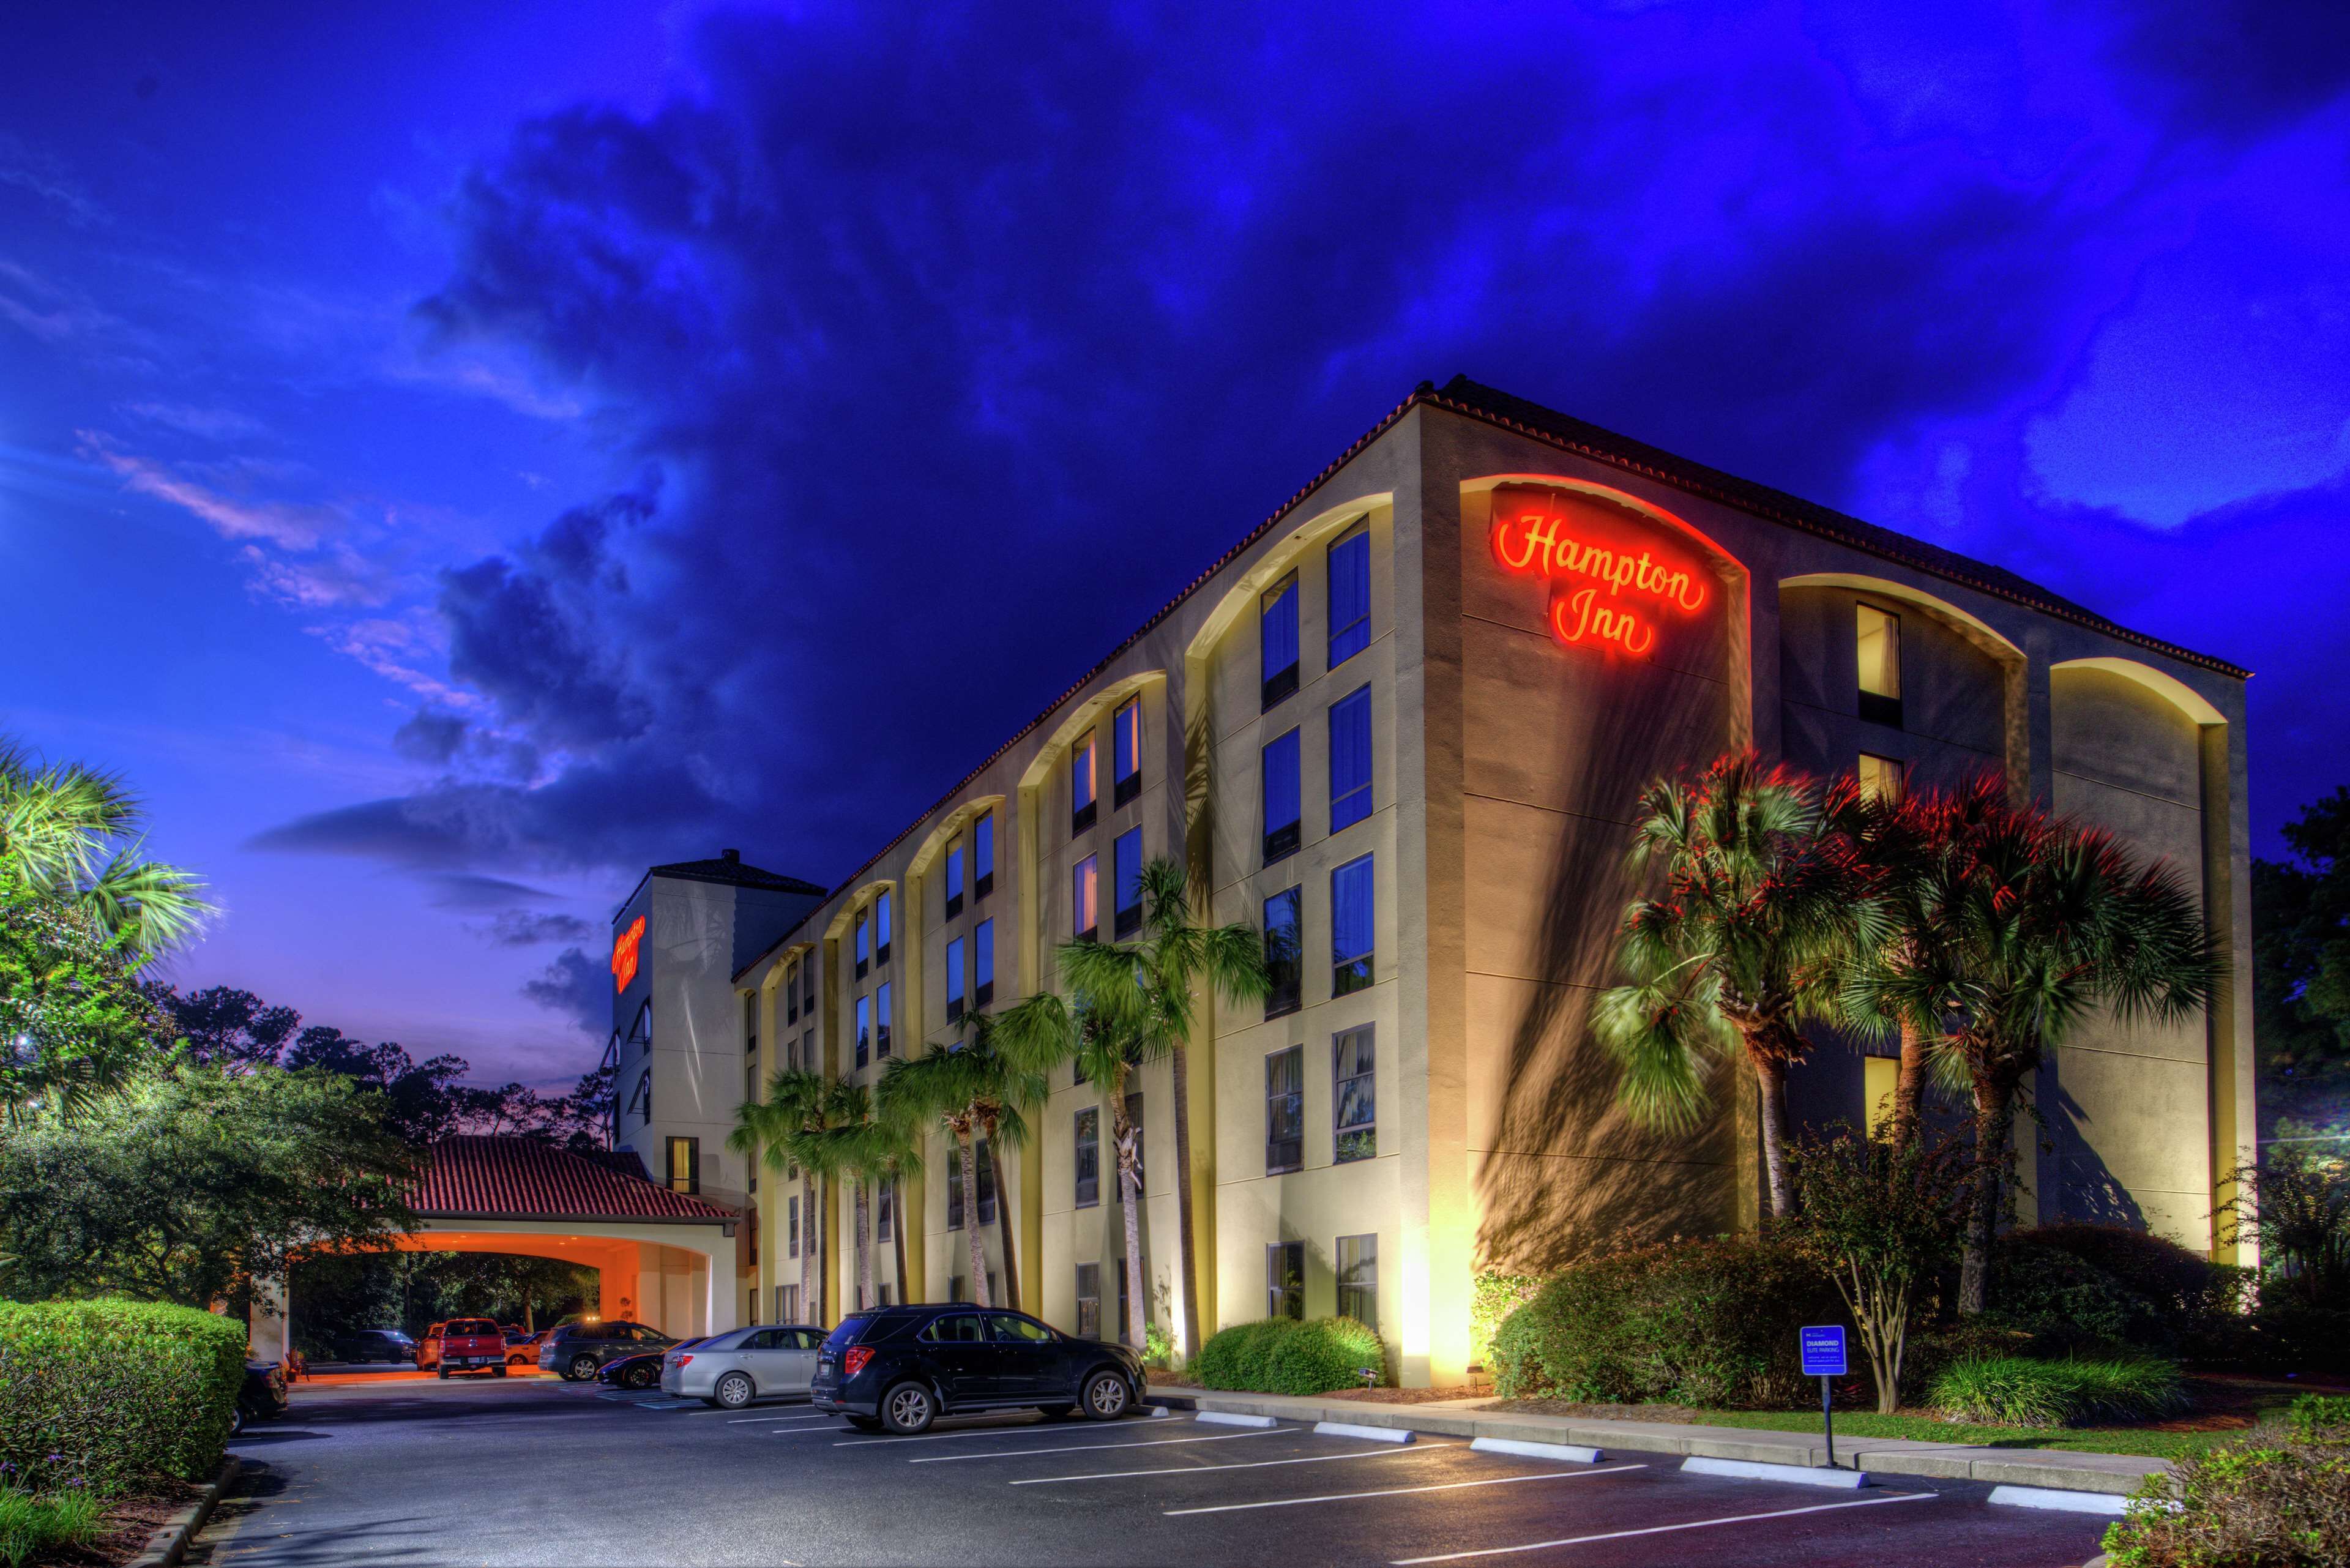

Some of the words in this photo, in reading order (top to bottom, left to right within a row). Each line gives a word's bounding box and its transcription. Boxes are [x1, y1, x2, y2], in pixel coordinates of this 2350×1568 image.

[1499, 515, 1704, 611] Hampton
[1556, 589, 1652, 653] Inn
[612, 917, 645, 971] Hampton
[618, 955, 637, 991] Inn
